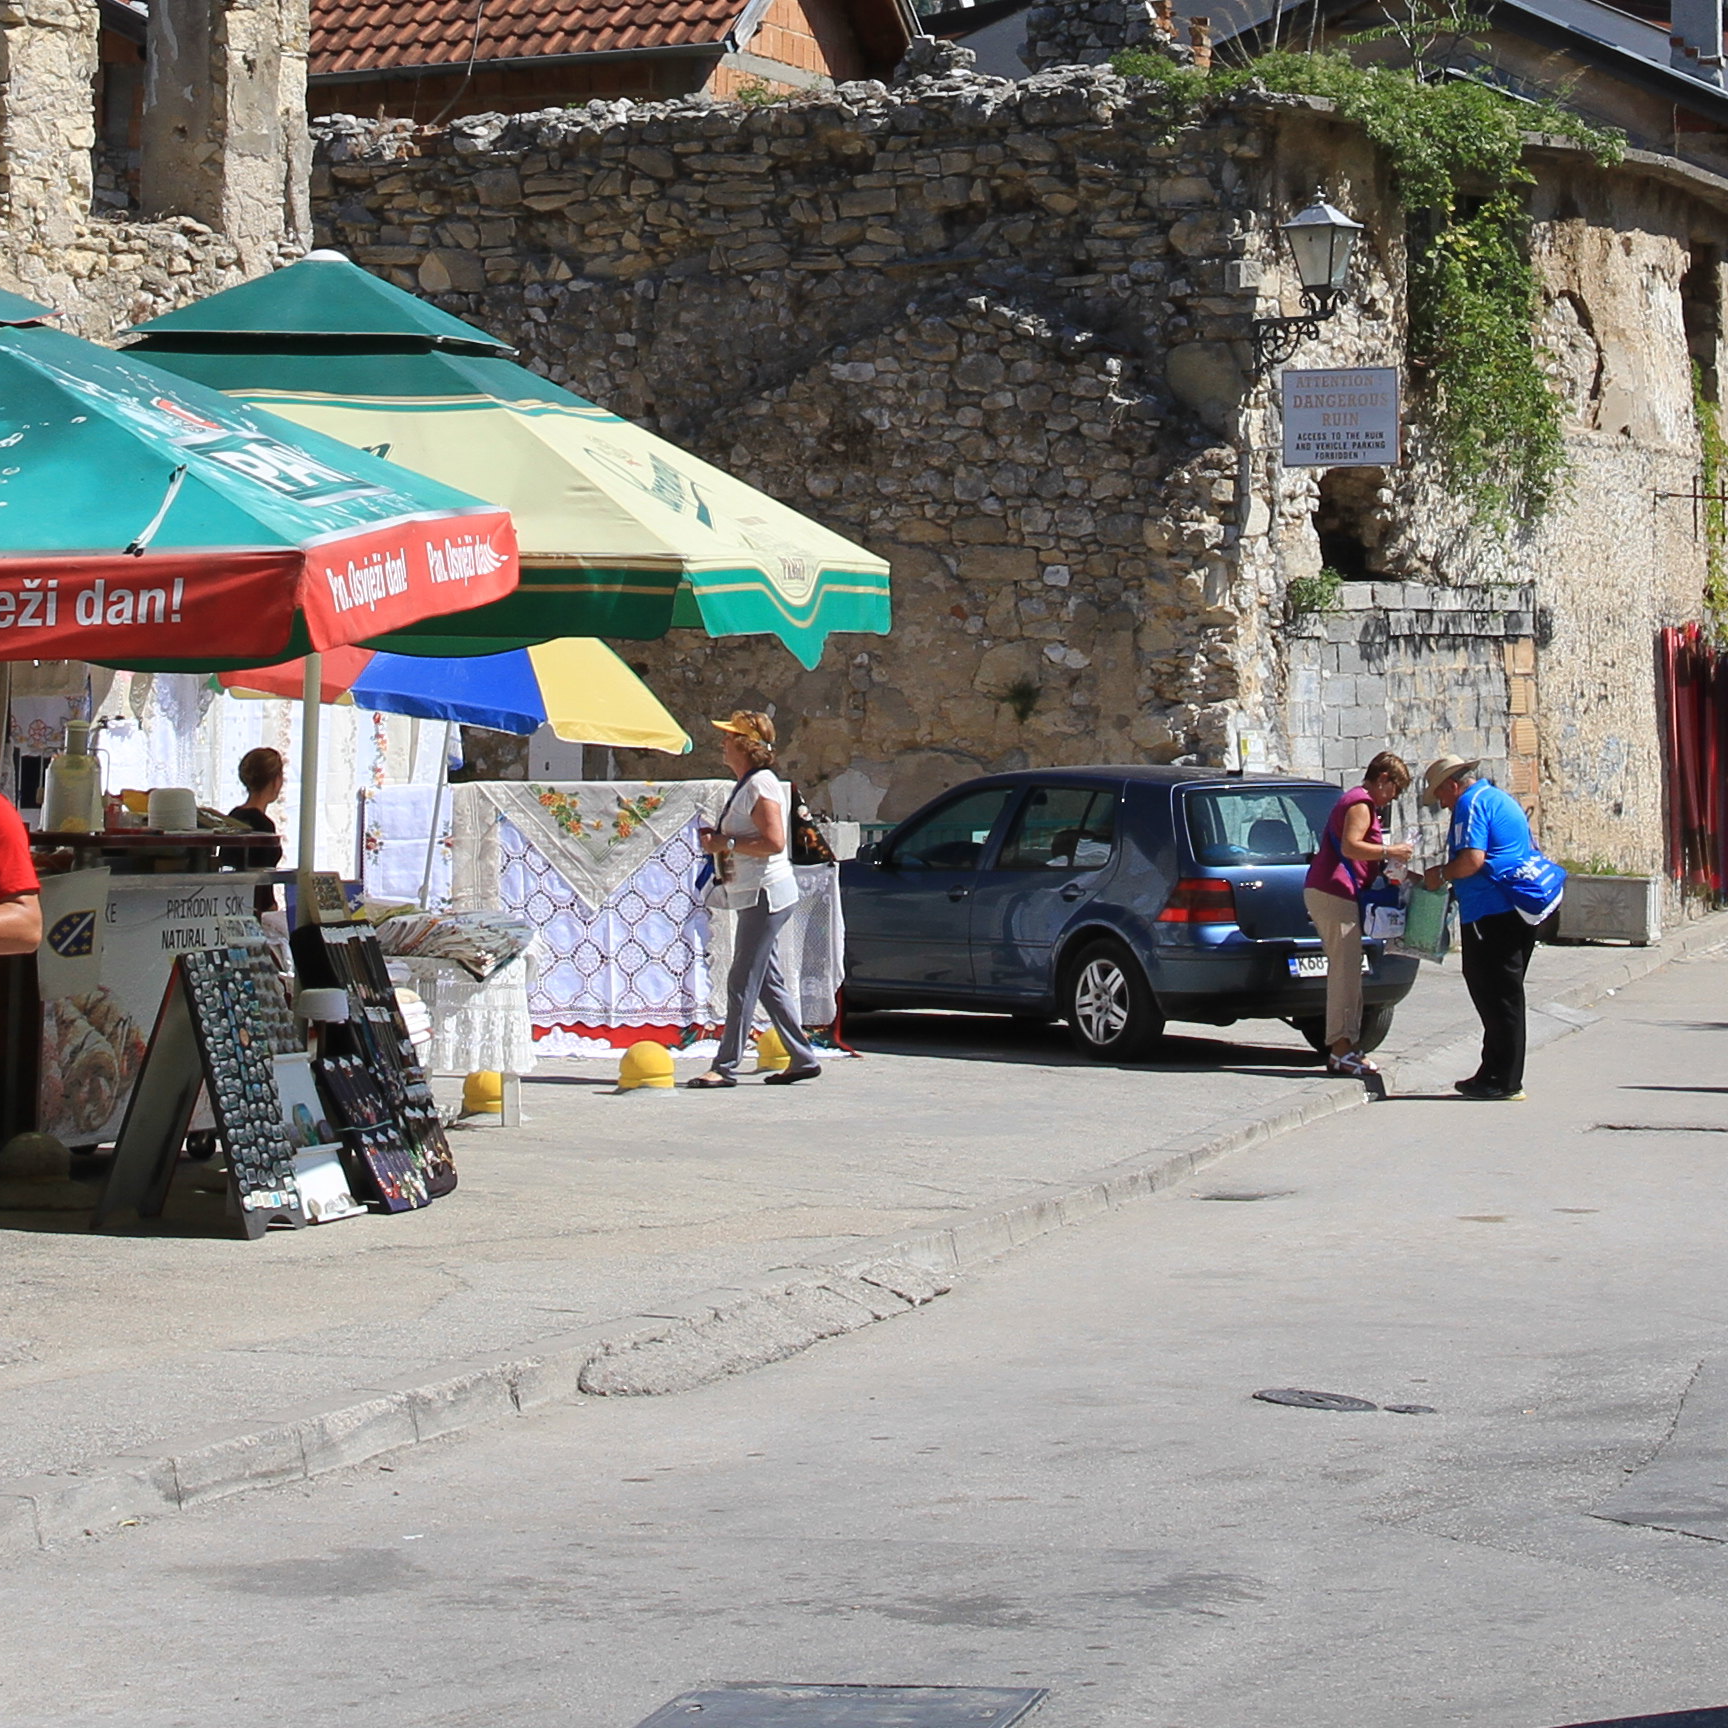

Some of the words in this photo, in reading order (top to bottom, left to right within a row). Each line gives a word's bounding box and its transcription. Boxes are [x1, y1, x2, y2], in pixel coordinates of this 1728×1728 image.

[1293, 393, 1388, 409] DANGEROUS
[1322, 413, 1360, 426] RUIN
[1298, 433, 1327, 441] ACCESS
[1332, 432, 1342, 440] TO
[1346, 432, 1360, 440] THE
[1365, 432, 1384, 440] RUIN
[1296, 442, 1312, 451] AND
[1315, 442, 1347, 451] VEHICLE
[1352, 441, 1386, 449] PARKING
[1315, 452, 1358, 460] FORBIDDEN
[75, 578, 185, 627] dan!
[167, 898, 219, 920] PRIRODNI
[225, 896, 245, 915] SOK
[161, 927, 207, 950] NATURAL
